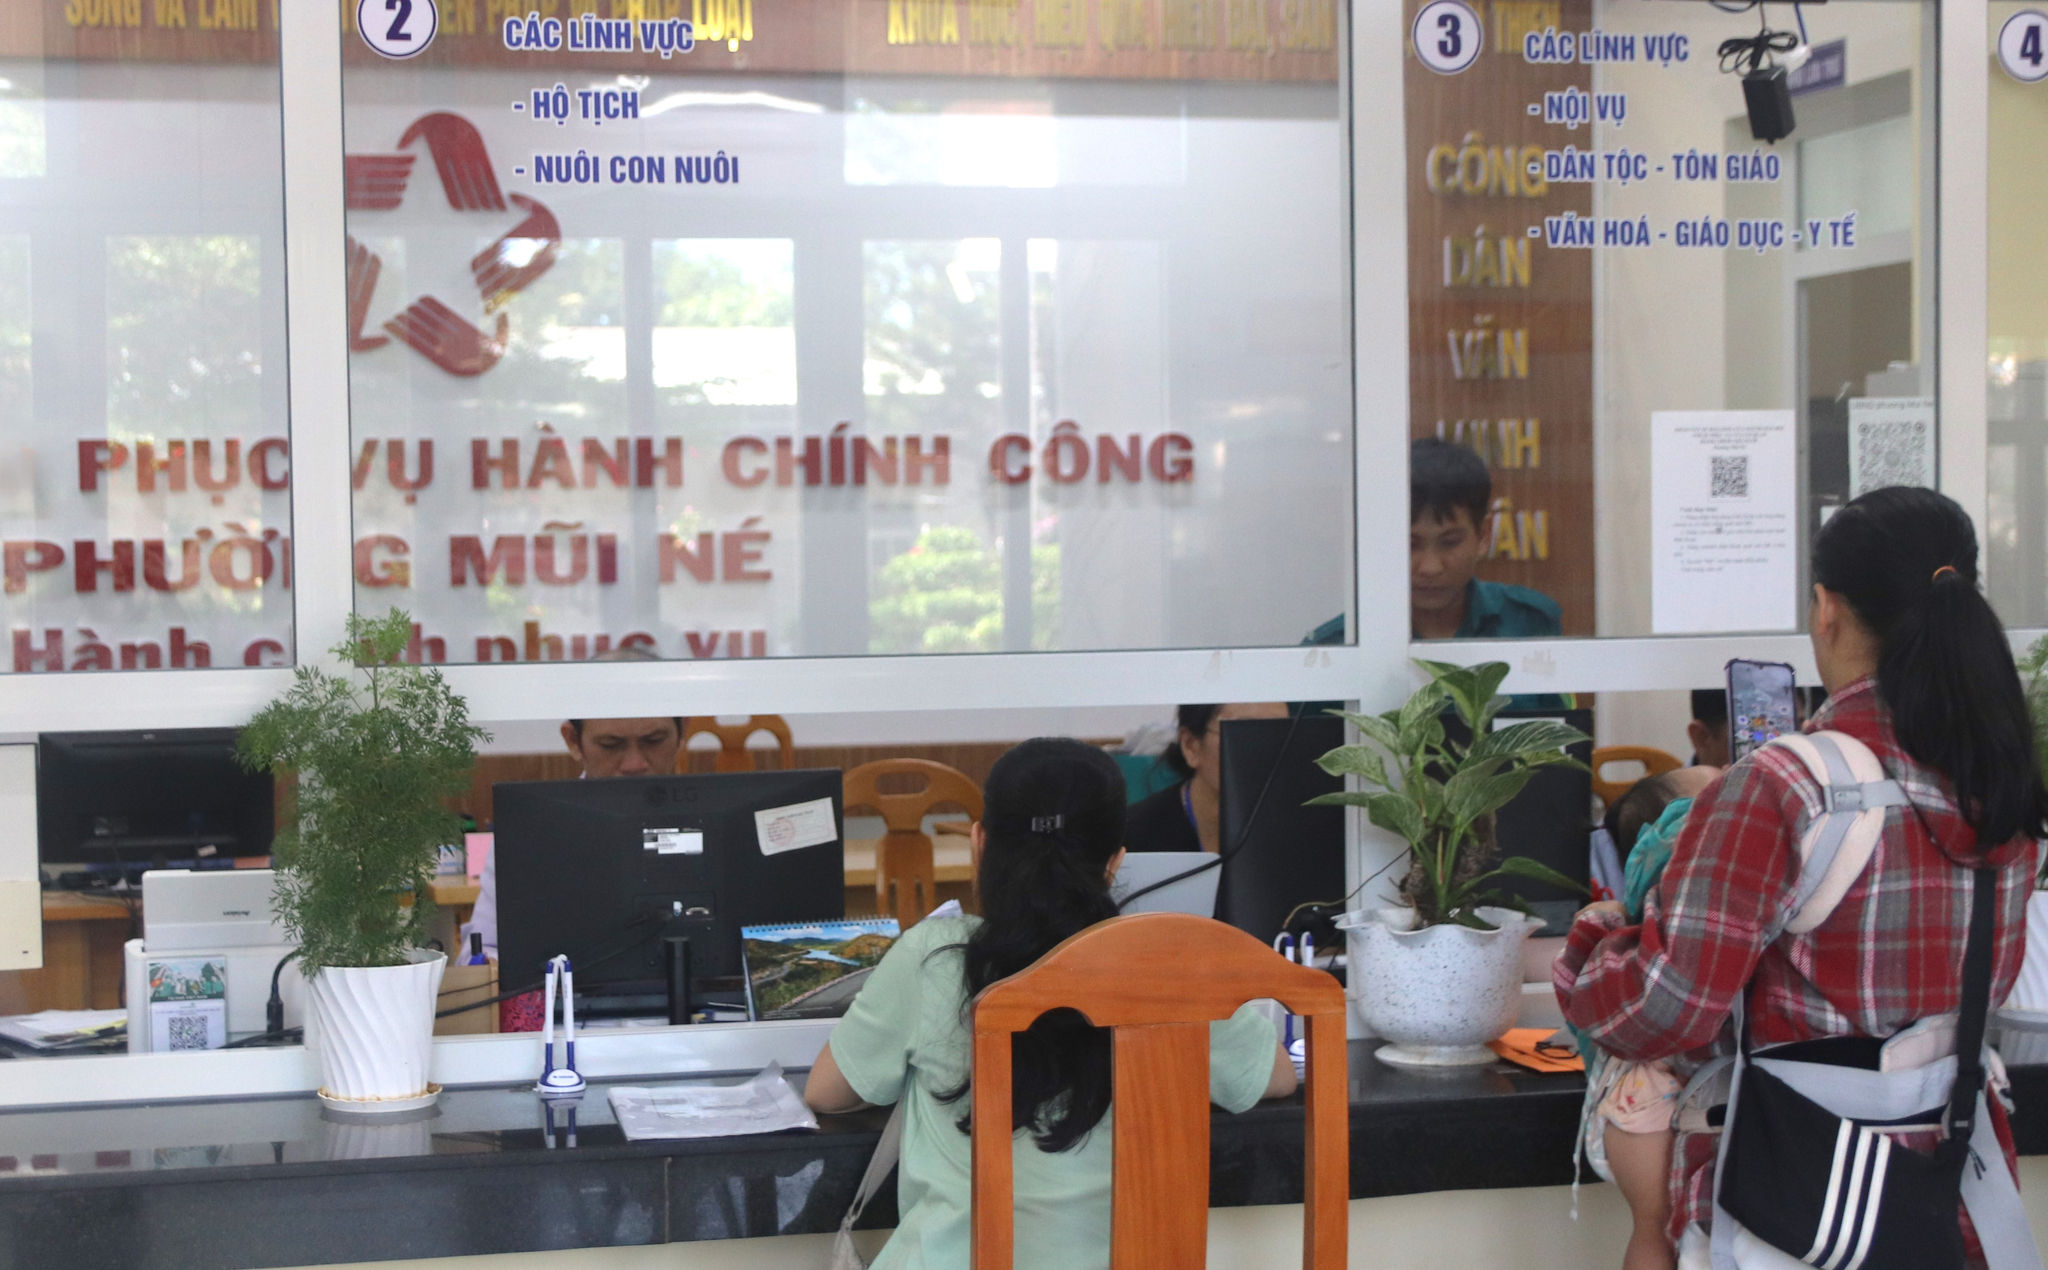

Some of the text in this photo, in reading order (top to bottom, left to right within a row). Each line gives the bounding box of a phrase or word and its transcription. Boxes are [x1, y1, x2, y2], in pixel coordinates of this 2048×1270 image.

[386, 0, 412, 42] 2
[505, 13, 560, 49] CÁC
[569, 14, 632, 50] LĨNH
[641, 19, 694, 57] VỰC
[1437, 14, 1462, 57] 3
[1526, 28, 1689, 67] CÁC LĨNH VỰC
[2020, 24, 2043, 65] 4
[533, 84, 569, 125] HỘ
[578, 90, 639, 126] TỊCH
[1548, 88, 1588, 127] NỘI
[1598, 95, 1626, 127] VỤ
[534, 149, 600, 184] NUÔI
[609, 155, 666, 184] CON
[674, 150, 739, 184] NUÔI
[1426, 130, 1548, 197] CÔNG
[1547, 147, 1595, 180] DÂN
[1604, 150, 1648, 185] TỘC
[1672, 150, 1718, 180] TÔN
[1726, 150, 1780, 180] GIÁO
[1548, 214, 1595, 246] VĂN
[1604, 216, 1650, 246] HOÁ
[1675, 217, 1730, 247] GIÁO
[1738, 221, 1784, 252] DỤC
[1808, 221, 1822, 247] Y
[1829, 212, 1856, 247] TẾ
[78, 438, 289, 505] PHỤC
[471, 421, 684, 489] HÀNH
[721, 421, 951, 488] CHÍNH
[989, 420, 1195, 485] CÔNG
[449, 520, 618, 587] MŨI
[658, 517, 773, 584] NÉ
[12, 627, 212, 672] Hành
